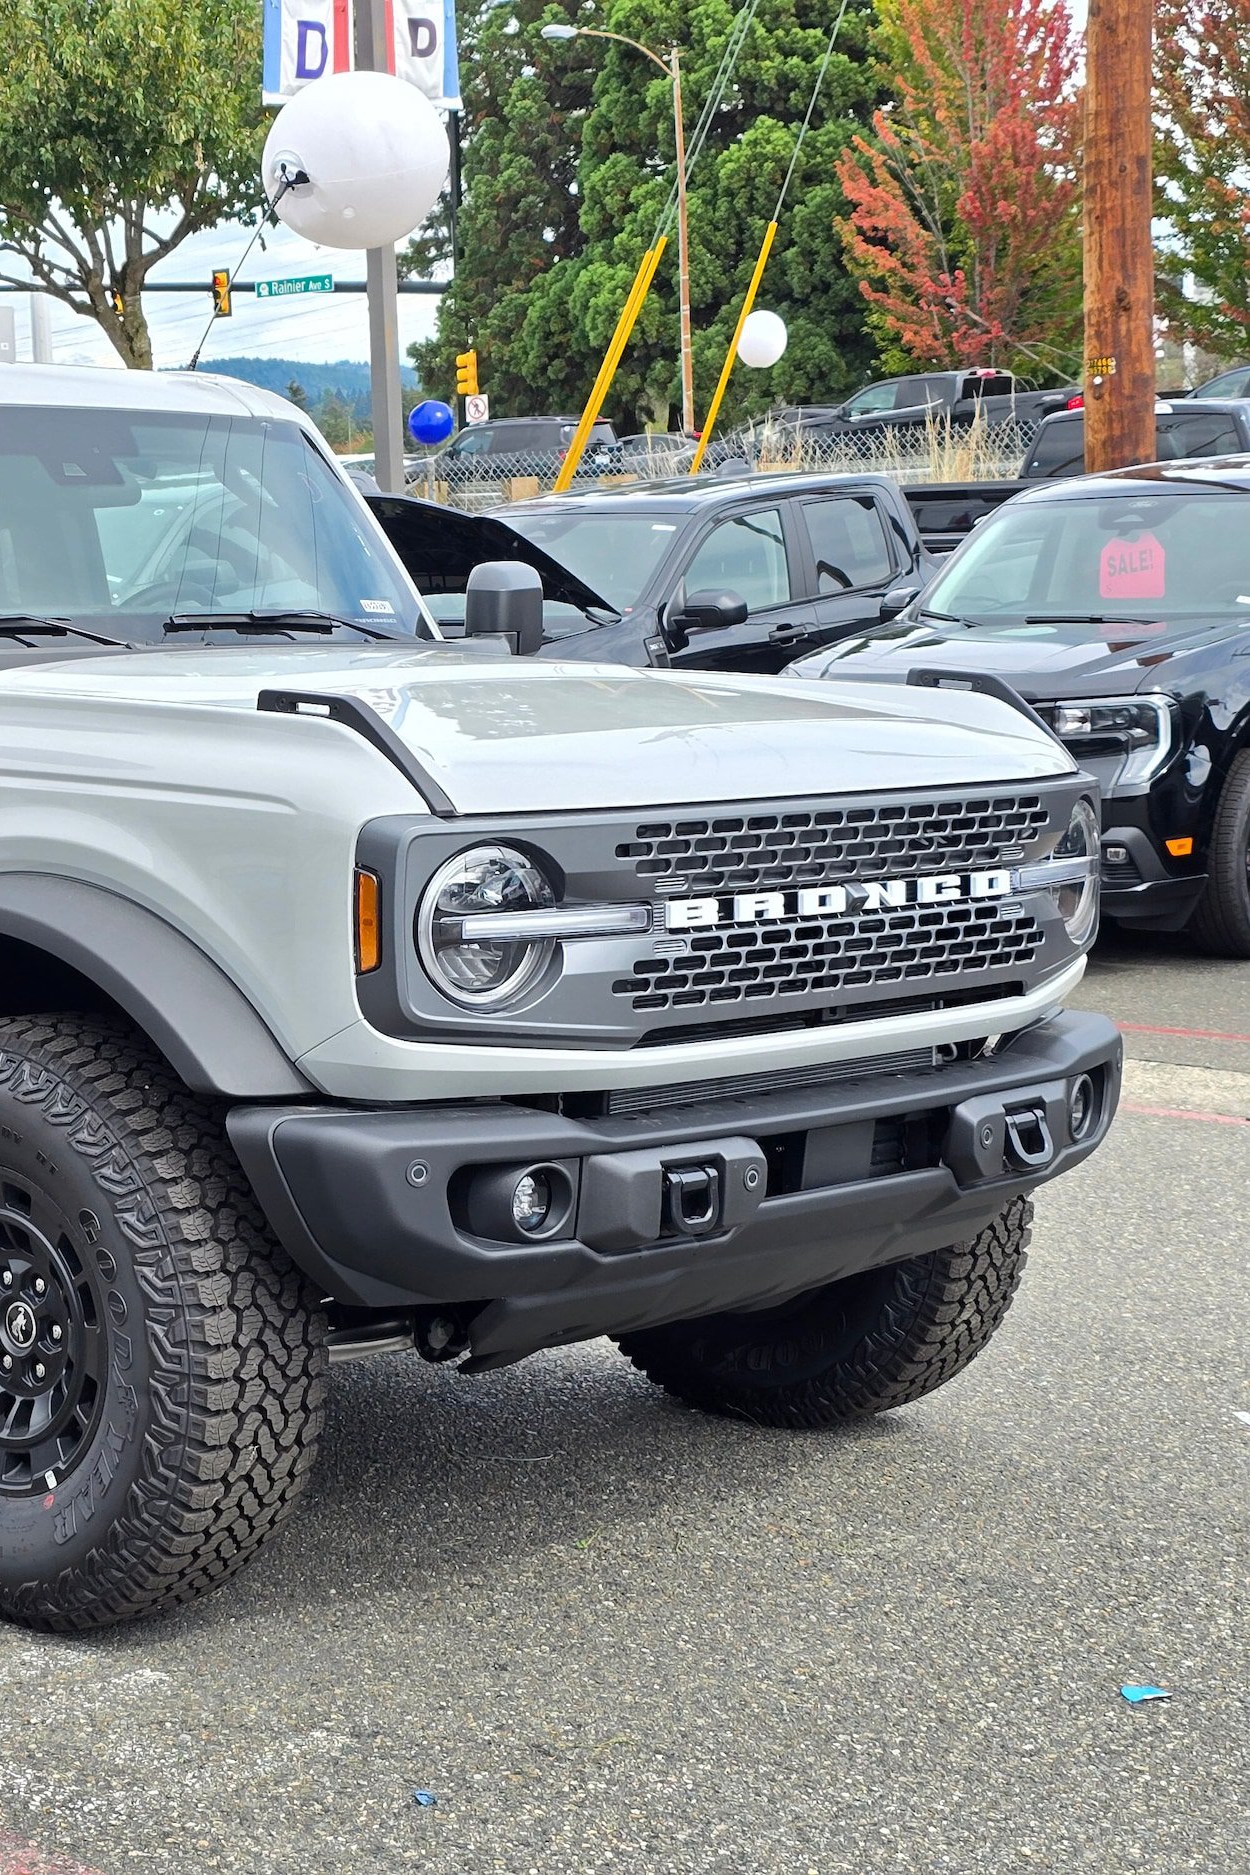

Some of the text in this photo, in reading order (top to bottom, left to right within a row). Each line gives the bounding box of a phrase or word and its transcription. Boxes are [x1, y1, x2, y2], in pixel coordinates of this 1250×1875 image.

[271, 280, 306, 295] Rainier
[324, 278, 330, 289] S
[1107, 549, 1154, 578] SALE!
[665, 869, 1011, 929] BRONCO
